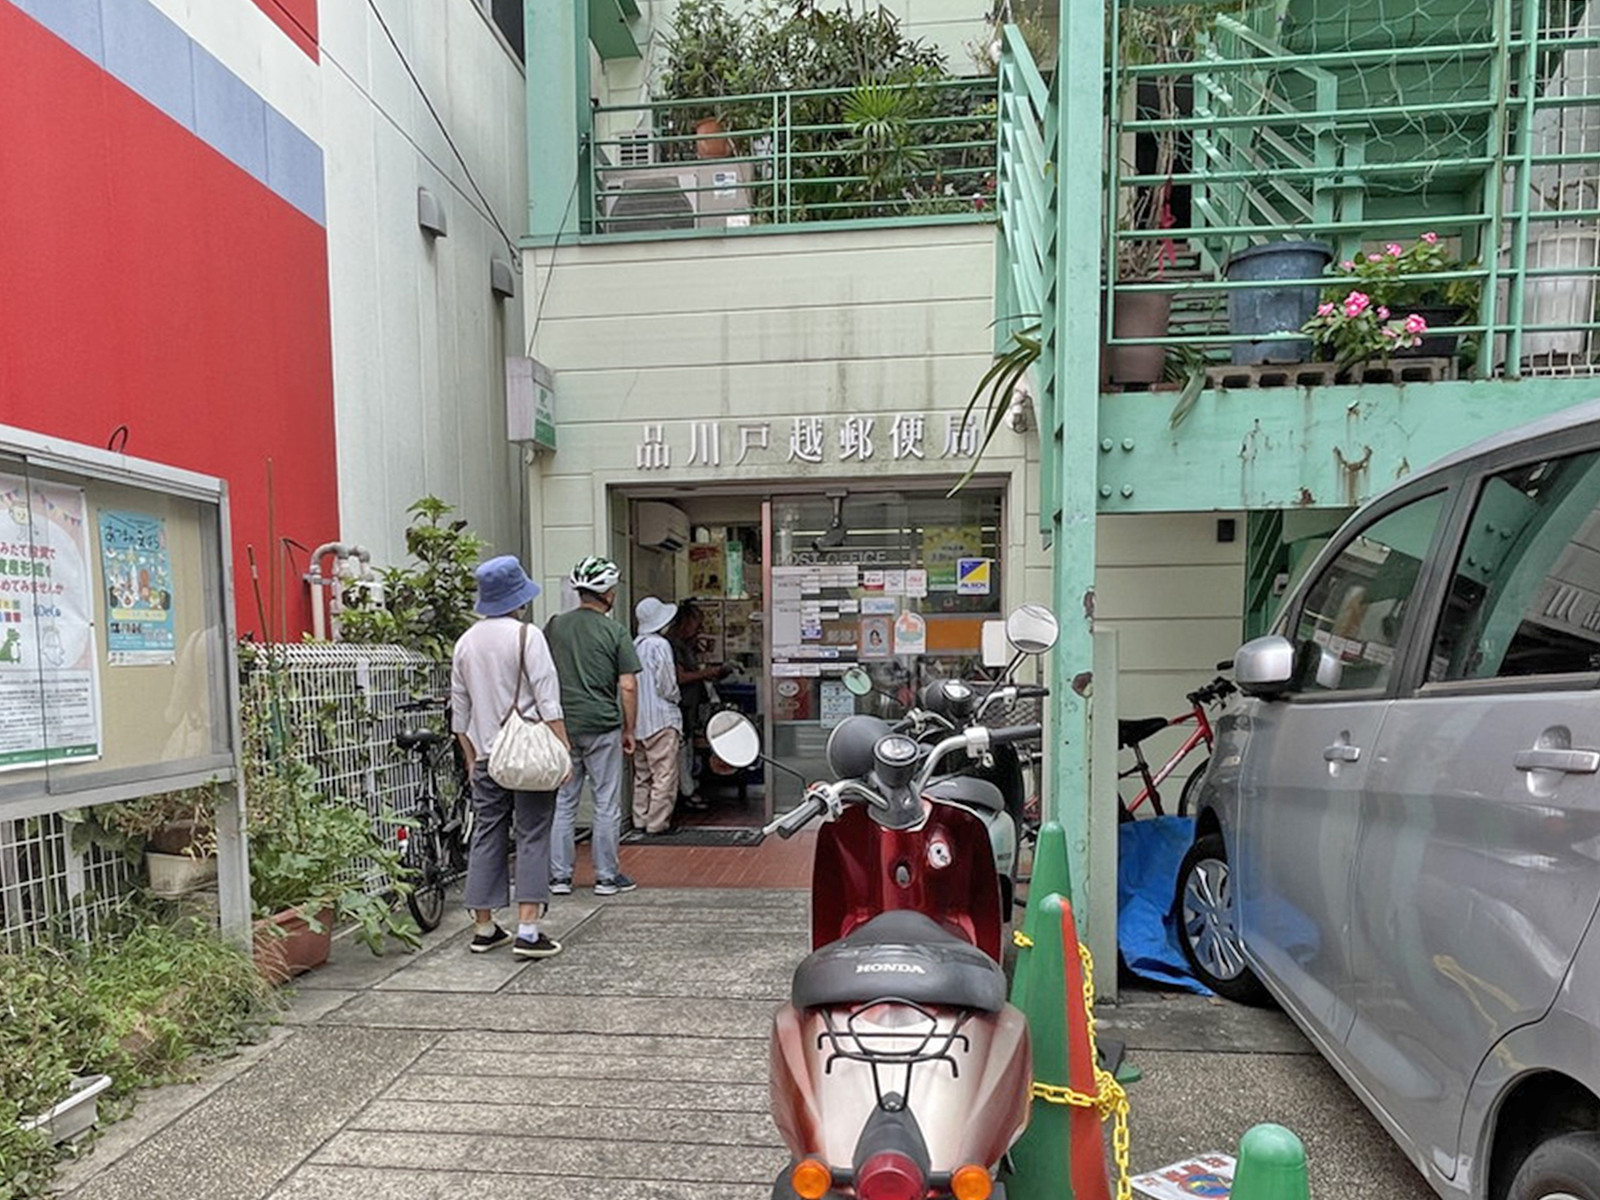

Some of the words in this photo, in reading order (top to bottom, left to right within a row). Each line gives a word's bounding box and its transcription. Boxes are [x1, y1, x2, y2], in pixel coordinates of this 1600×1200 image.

[636, 412, 979, 469] 品川戸越郵便局
[855, 962, 926, 975] HONDA
